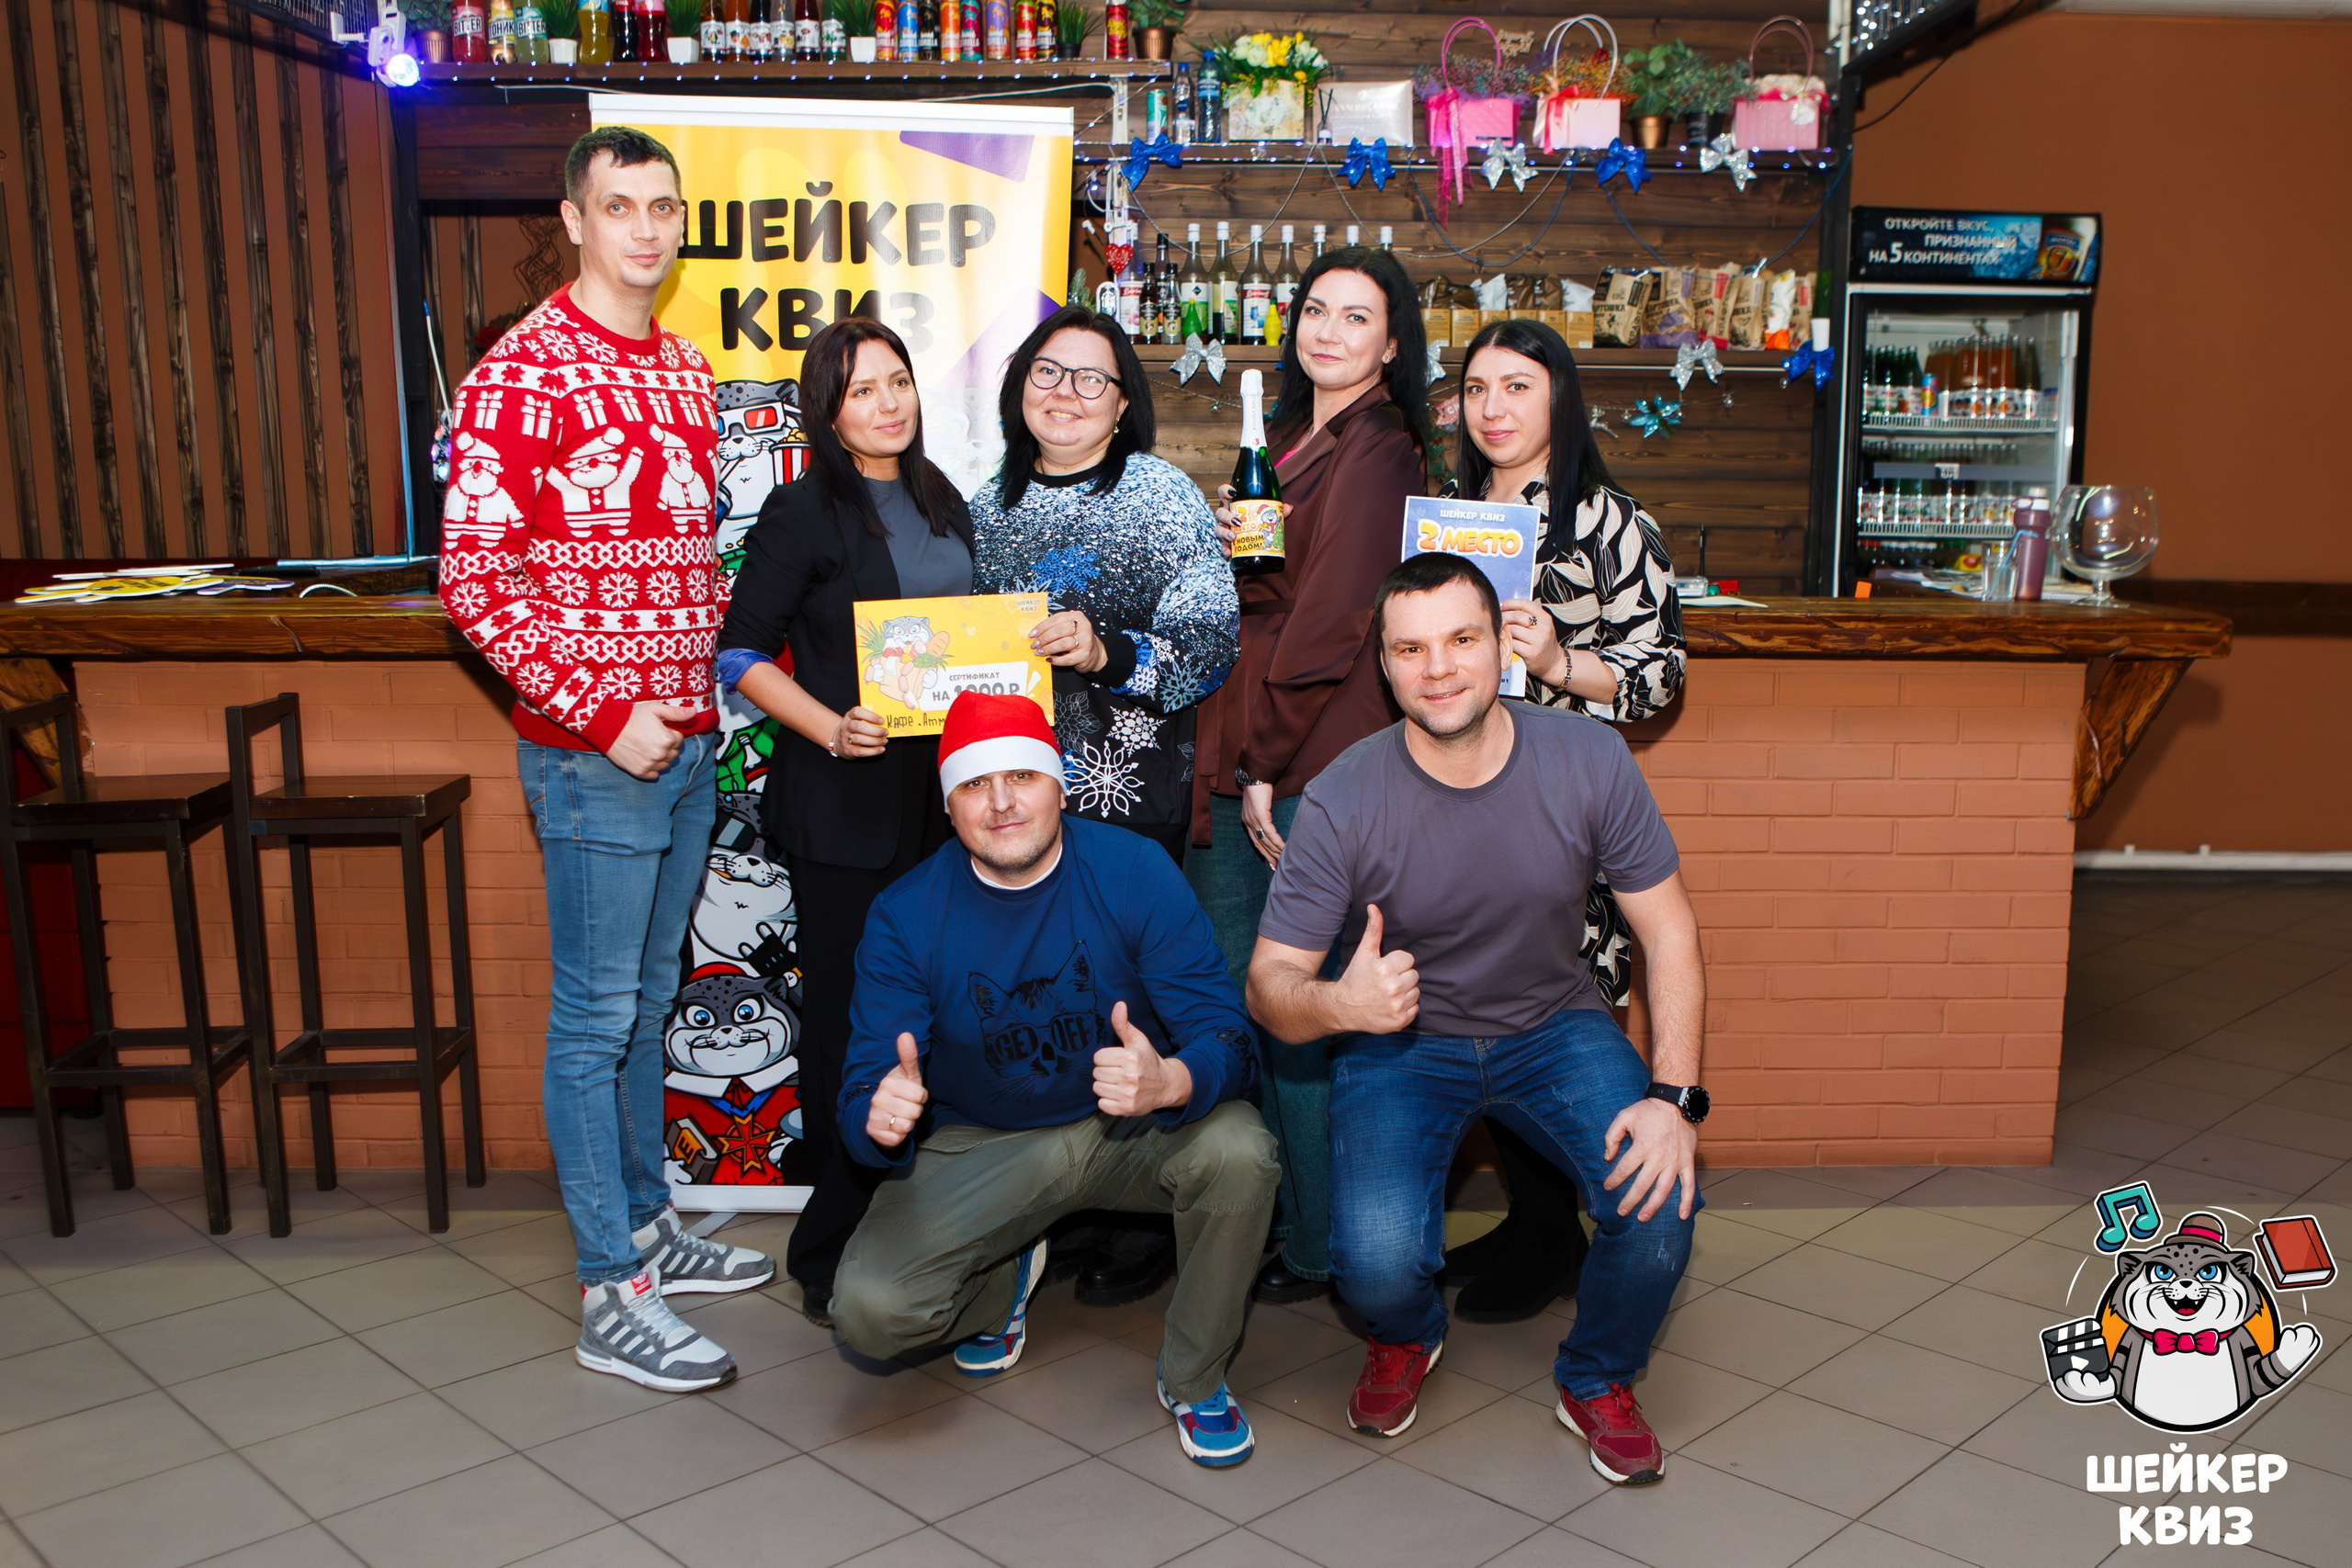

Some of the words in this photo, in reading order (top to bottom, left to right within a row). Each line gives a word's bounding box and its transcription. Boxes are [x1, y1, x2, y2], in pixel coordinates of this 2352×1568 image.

[518, 19, 546, 36] BITER
[678, 181, 996, 267] ШЕЙКЕР
[1884, 217, 1954, 231] ОТКРОЙТЕ
[1957, 218, 1995, 233] ВКУС,
[1924, 233, 2018, 250] ПРИЗНАННЫЙ
[1869, 249, 1887, 264] НА
[1889, 242, 1904, 264] 5
[1903, 250, 2001, 265] КОНТИНЕНТАХ
[1237, 506, 1248, 523] 2
[1440, 509, 1477, 520] ШЕЙКЕР
[1480, 513, 1506, 522] КВИЗ
[1237, 535, 1264, 545] НОВЫМ
[1419, 522, 1438, 550] 2
[1442, 529, 1521, 555] МЕСТО
[1234, 543, 1262, 553] ГОДОМ!
[949, 672, 1000, 682] СЕРТИФИКАТ
[933, 691, 950, 702] НА
[1050, 1016, 1093, 1052] OFF
